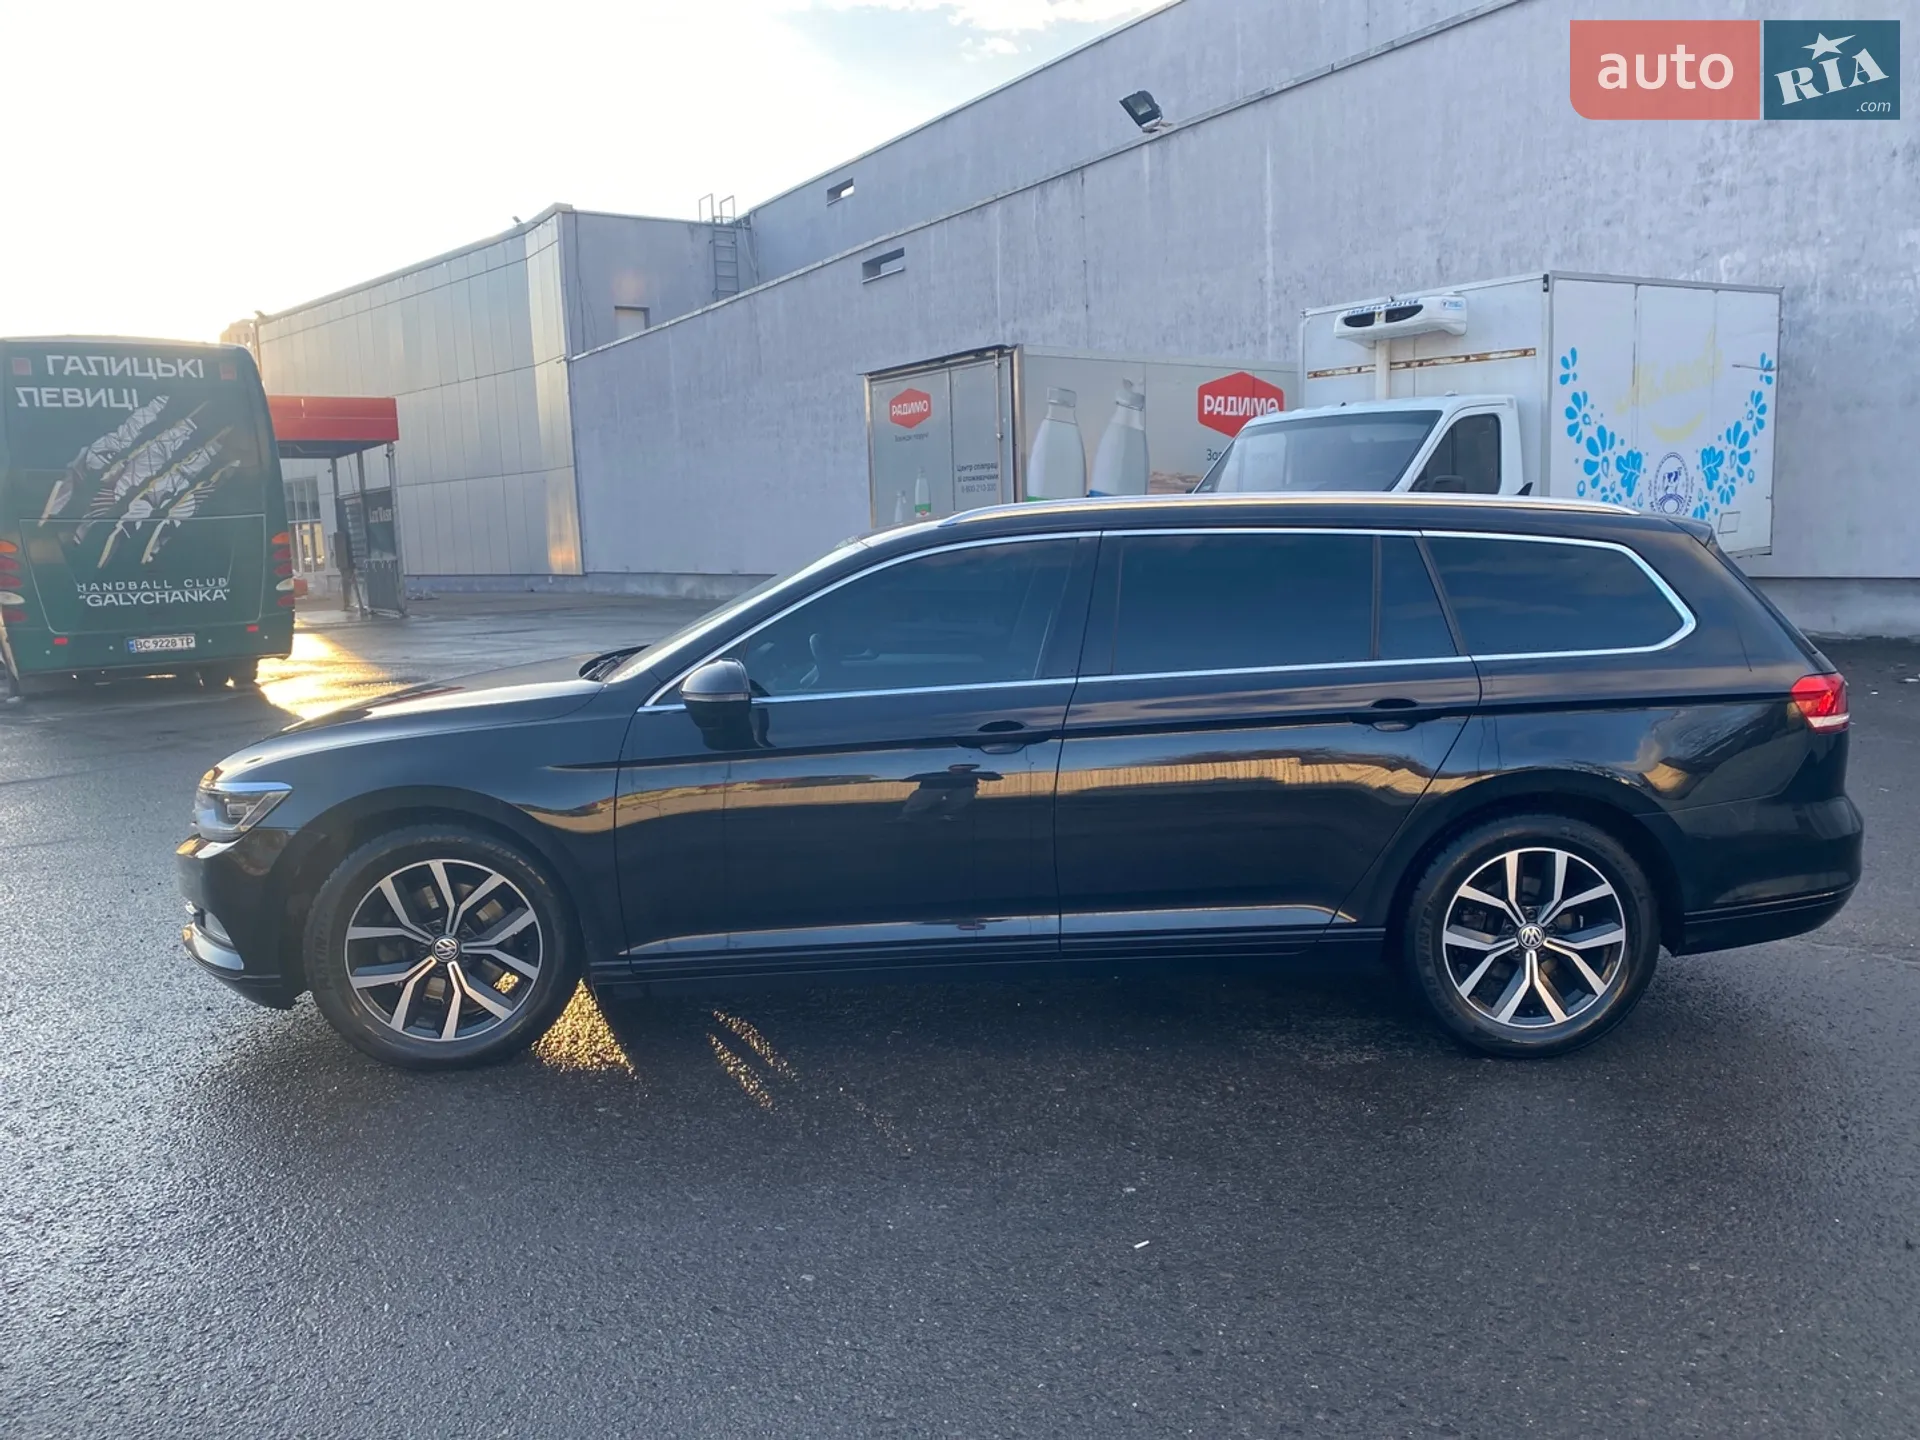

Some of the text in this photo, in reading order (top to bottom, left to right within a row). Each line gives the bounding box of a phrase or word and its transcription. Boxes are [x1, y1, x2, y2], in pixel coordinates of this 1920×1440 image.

[46, 355, 205, 380] ГАЛИЦЬКІ
[15, 386, 139, 410] ЛЕВИЦІ
[891, 400, 929, 417] РАДИМО
[1203, 394, 1280, 416] РАДИМО
[77, 577, 228, 592] HANDBALL CLUB
